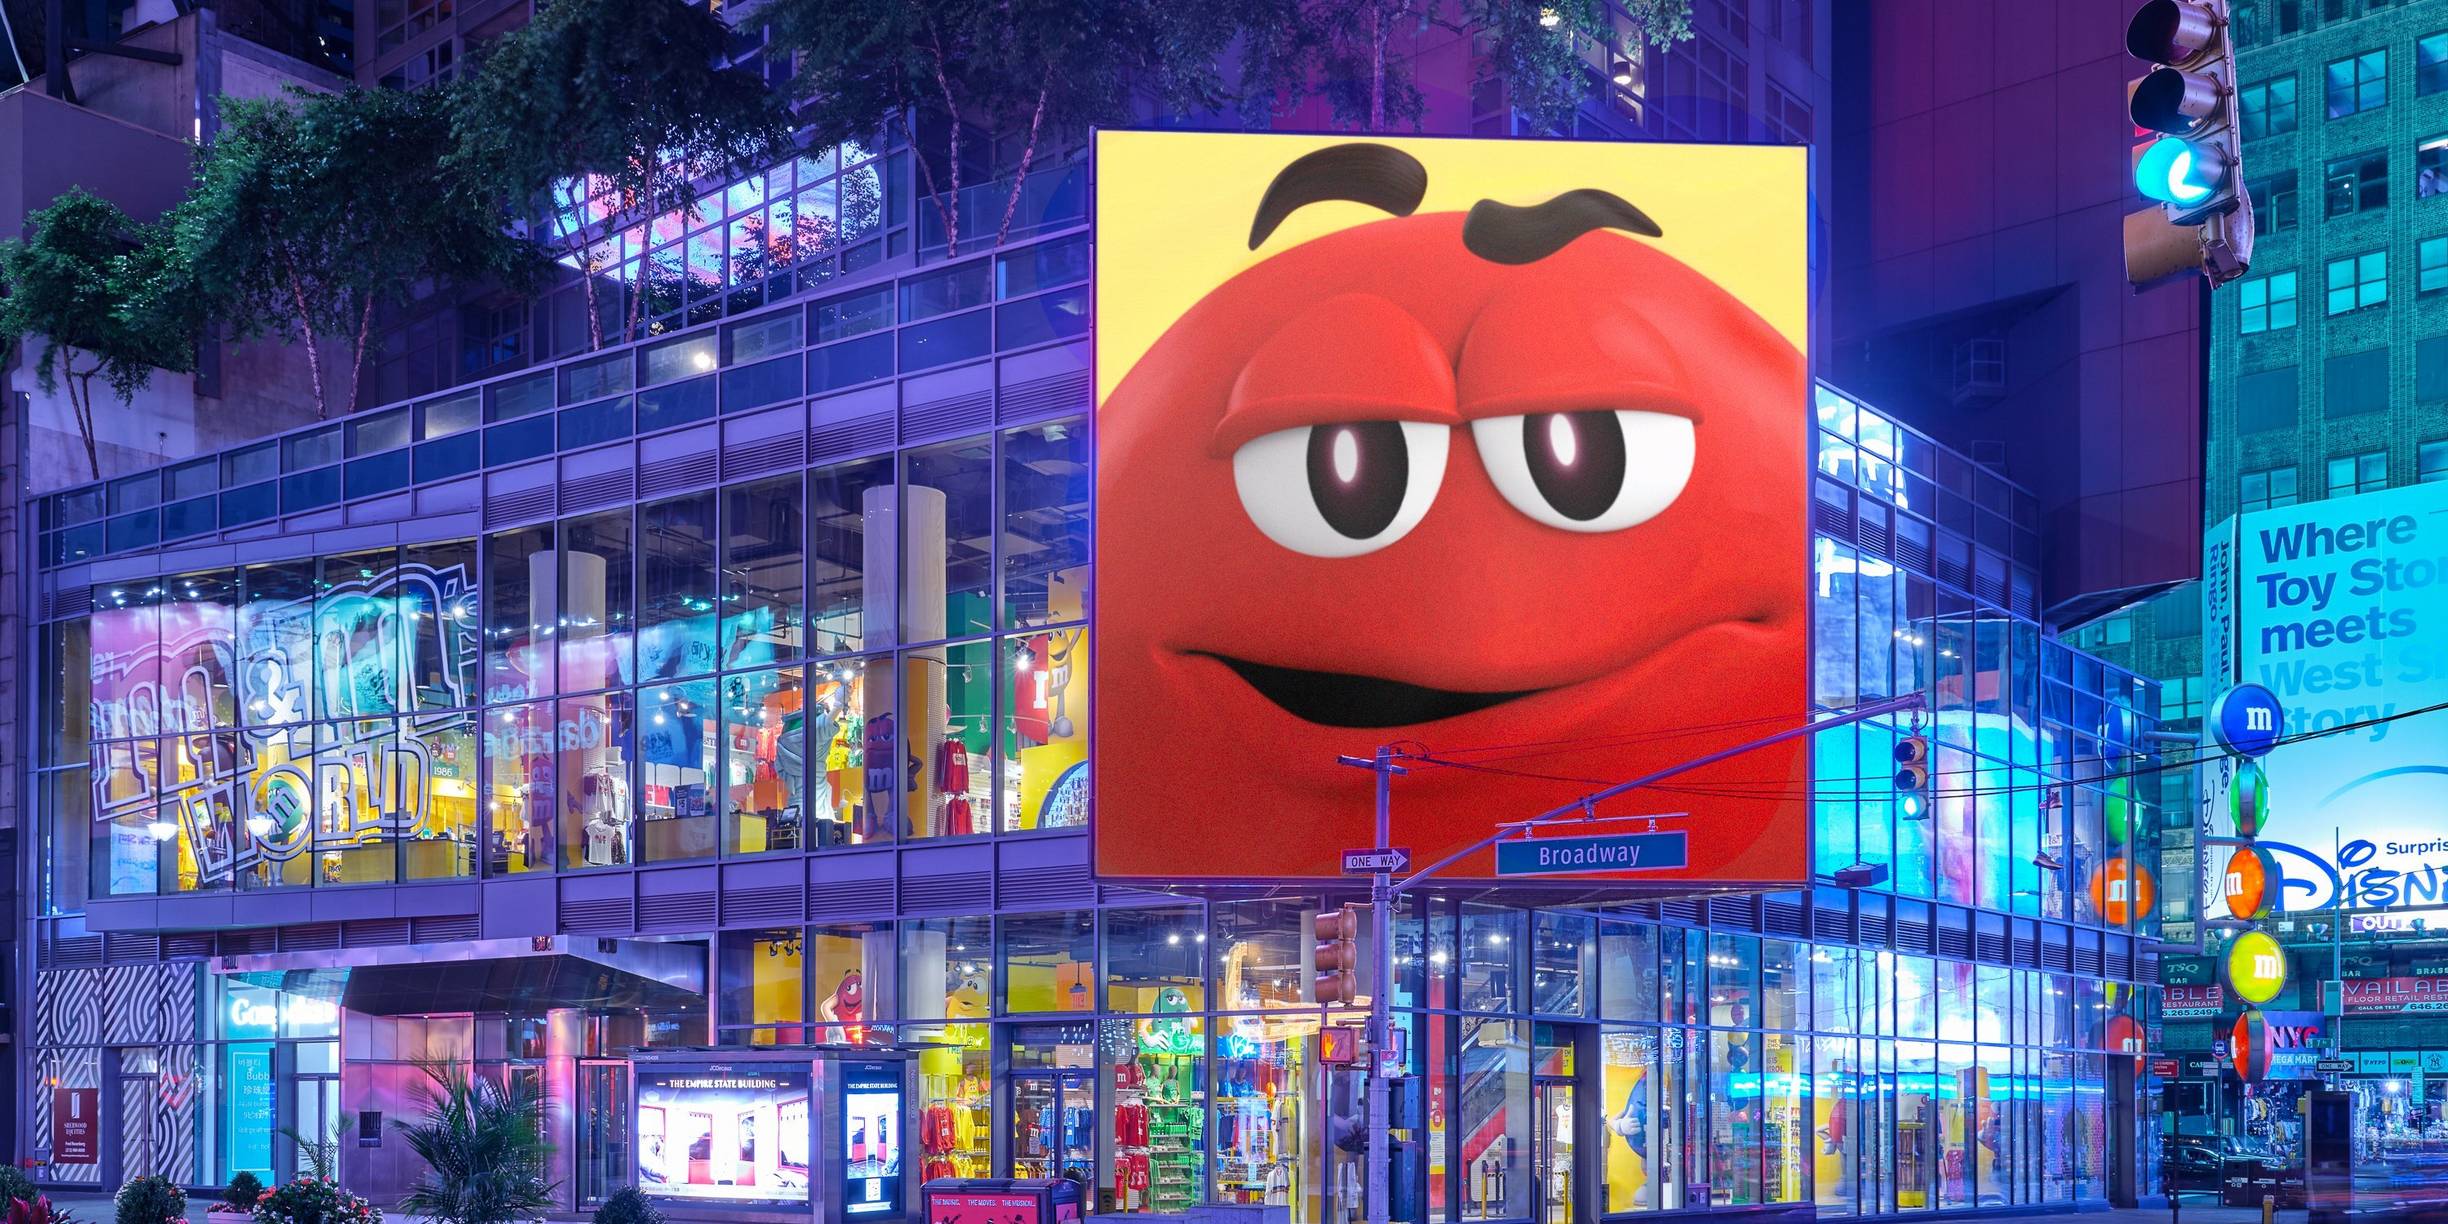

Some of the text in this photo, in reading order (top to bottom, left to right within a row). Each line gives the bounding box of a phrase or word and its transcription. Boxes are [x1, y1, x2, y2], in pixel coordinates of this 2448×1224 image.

[2260, 515, 2417, 564] Where
[2208, 543, 2218, 623] Ringo
[2256, 572, 2337, 612] Toy
[2261, 606, 2417, 654] meets
[2259, 653, 2384, 697] West
[2246, 707, 2273, 731] m
[434, 766, 453, 777] 1986
[1351, 855, 1400, 867] ONE WAY
[1539, 844, 1641, 867] Broadway
[2226, 871, 2244, 897] m
[2167, 963, 2199, 973] TSQ
[2295, 1055, 2318, 1064] MART
[670, 1080, 776, 1088] THE EMPIRE STATE BUILDING
[1117, 1072, 1127, 1082] m
